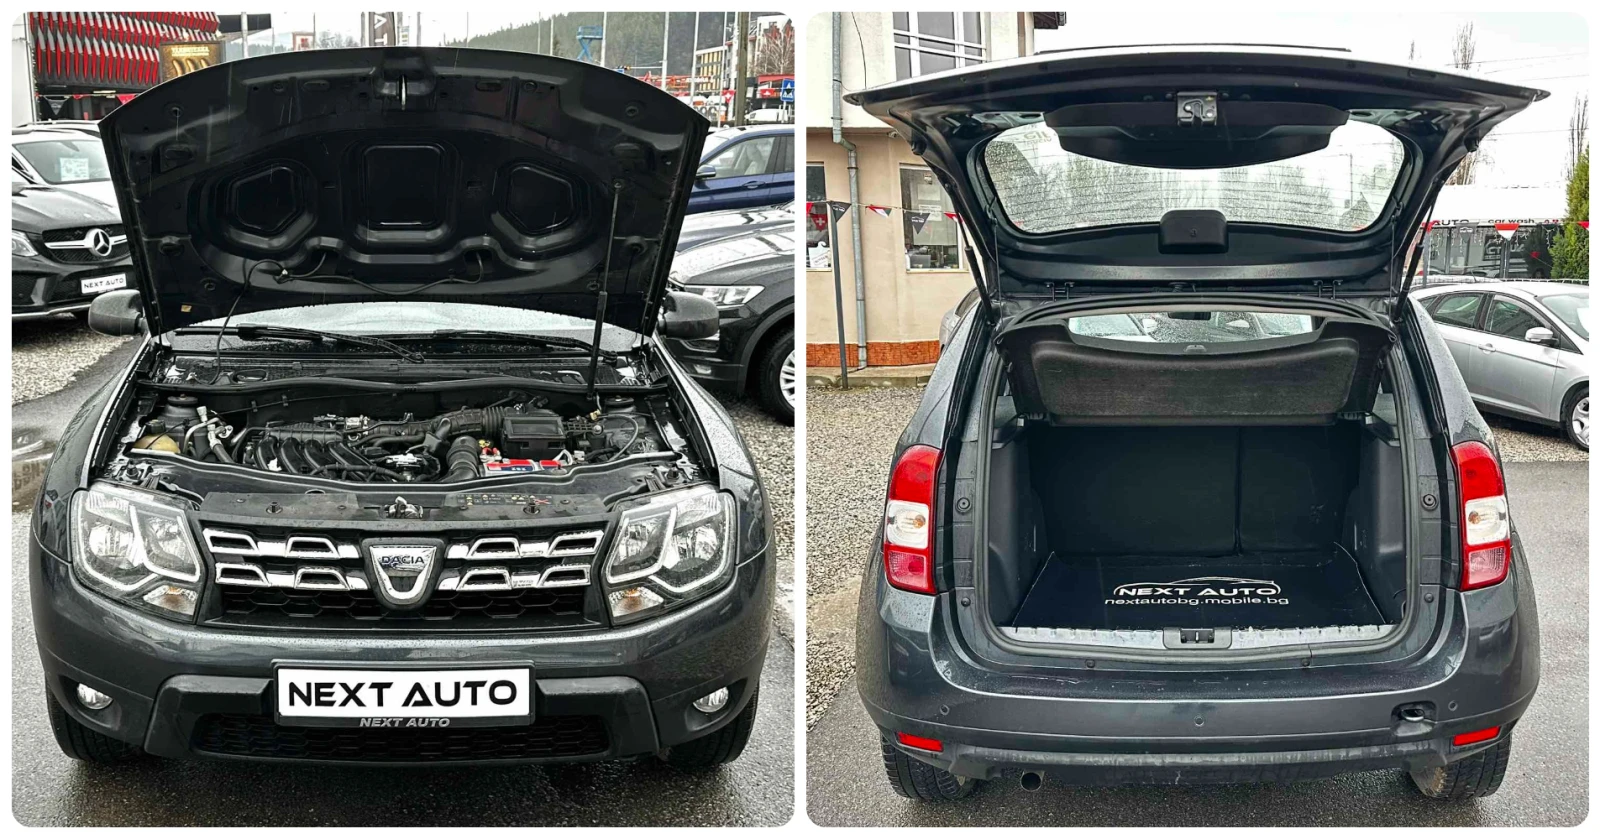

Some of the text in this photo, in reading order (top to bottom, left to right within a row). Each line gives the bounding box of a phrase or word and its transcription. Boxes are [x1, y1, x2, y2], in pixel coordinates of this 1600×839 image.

[84, 281, 103, 289] NEXT
[381, 556, 425, 564] DACIA
[1118, 587, 1277, 596] NEXT AUTO
[1104, 597, 1289, 606] nextautobg.mobile.bg
[289, 680, 518, 707] NEXT AUTO
[359, 718, 451, 728] NEXT AUTO
